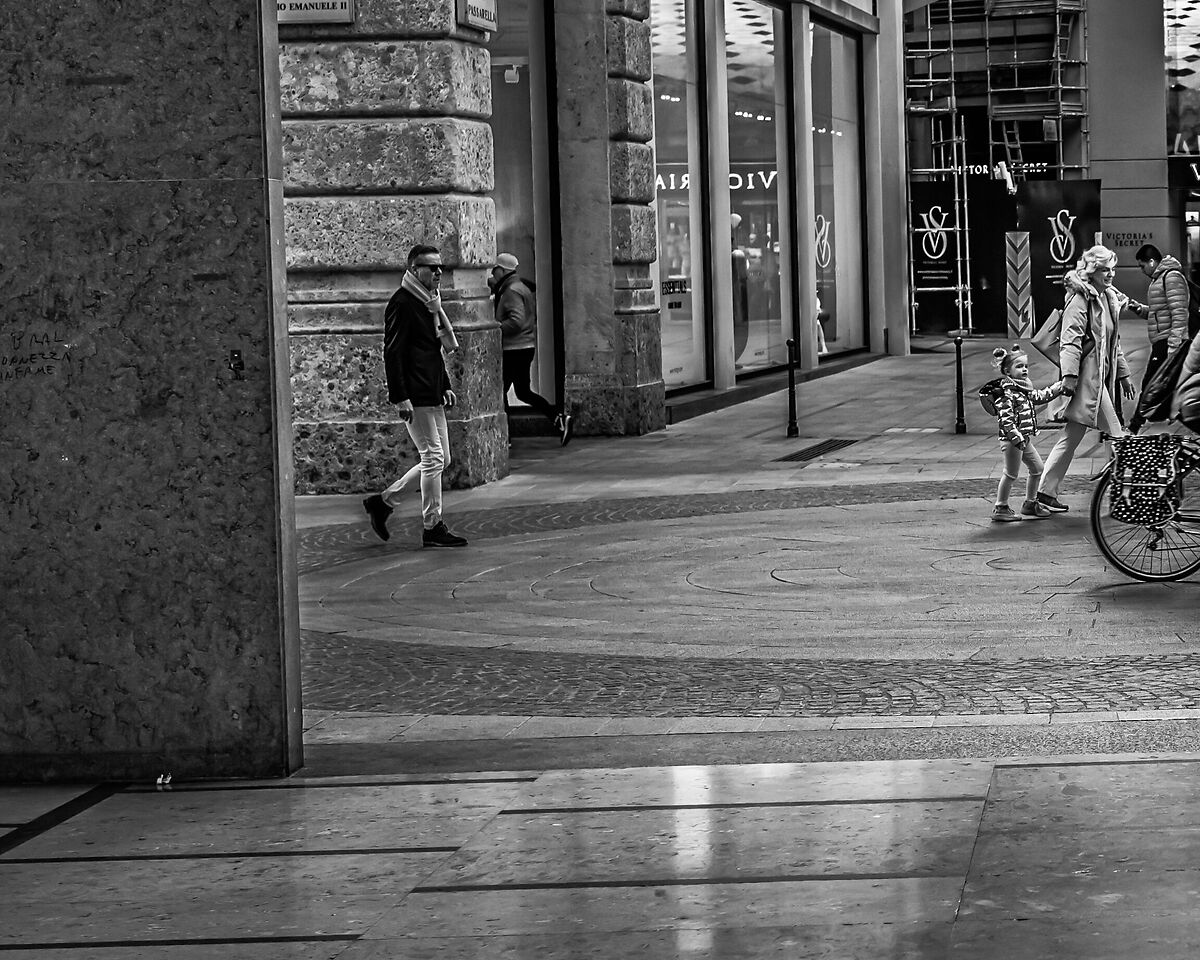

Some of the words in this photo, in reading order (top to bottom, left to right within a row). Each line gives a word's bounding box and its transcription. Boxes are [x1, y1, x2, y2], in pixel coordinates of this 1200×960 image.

[289, 2, 338, 11] EMANUELE
[340, 1, 347, 10] II
[468, 4, 497, 23] PASSARELLA
[1106, 232, 1153, 240] VICTORIA'S
